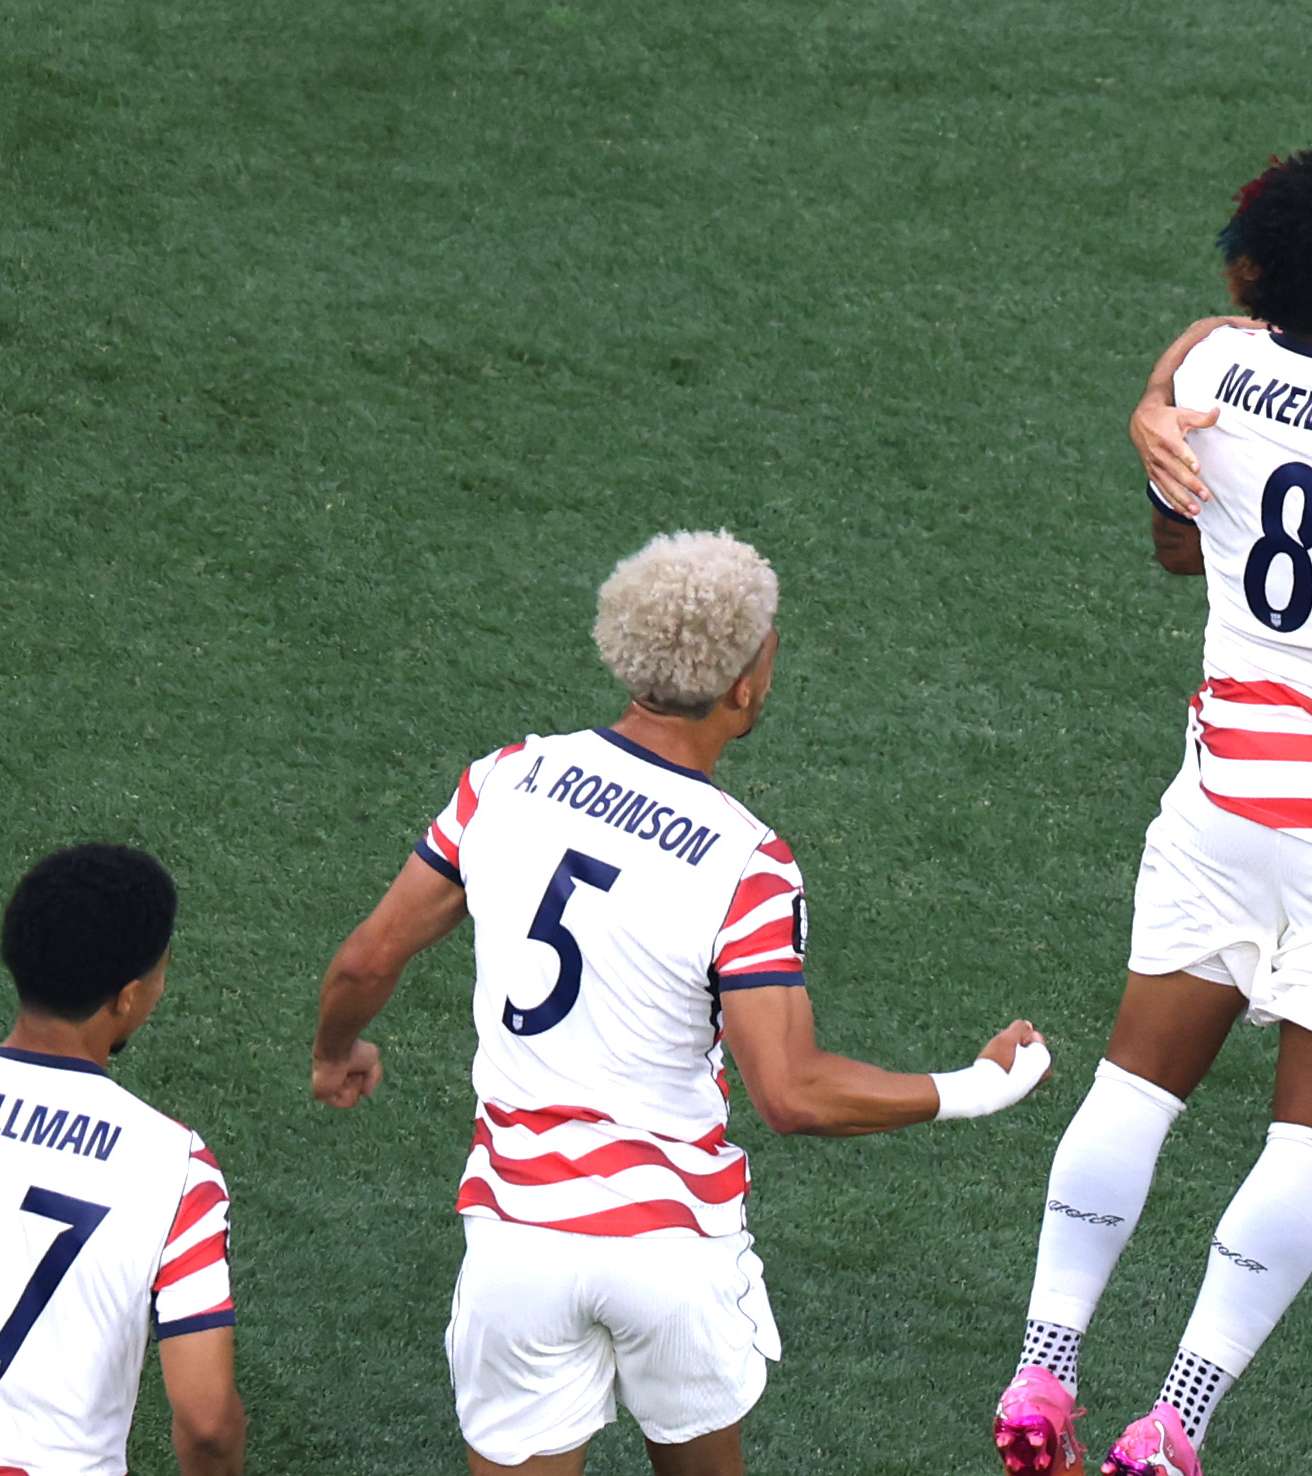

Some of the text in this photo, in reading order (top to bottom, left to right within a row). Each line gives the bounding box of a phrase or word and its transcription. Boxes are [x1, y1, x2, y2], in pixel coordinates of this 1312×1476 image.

[514, 755, 721, 866] A. ROBINSON
[502, 848, 622, 1036] 5
